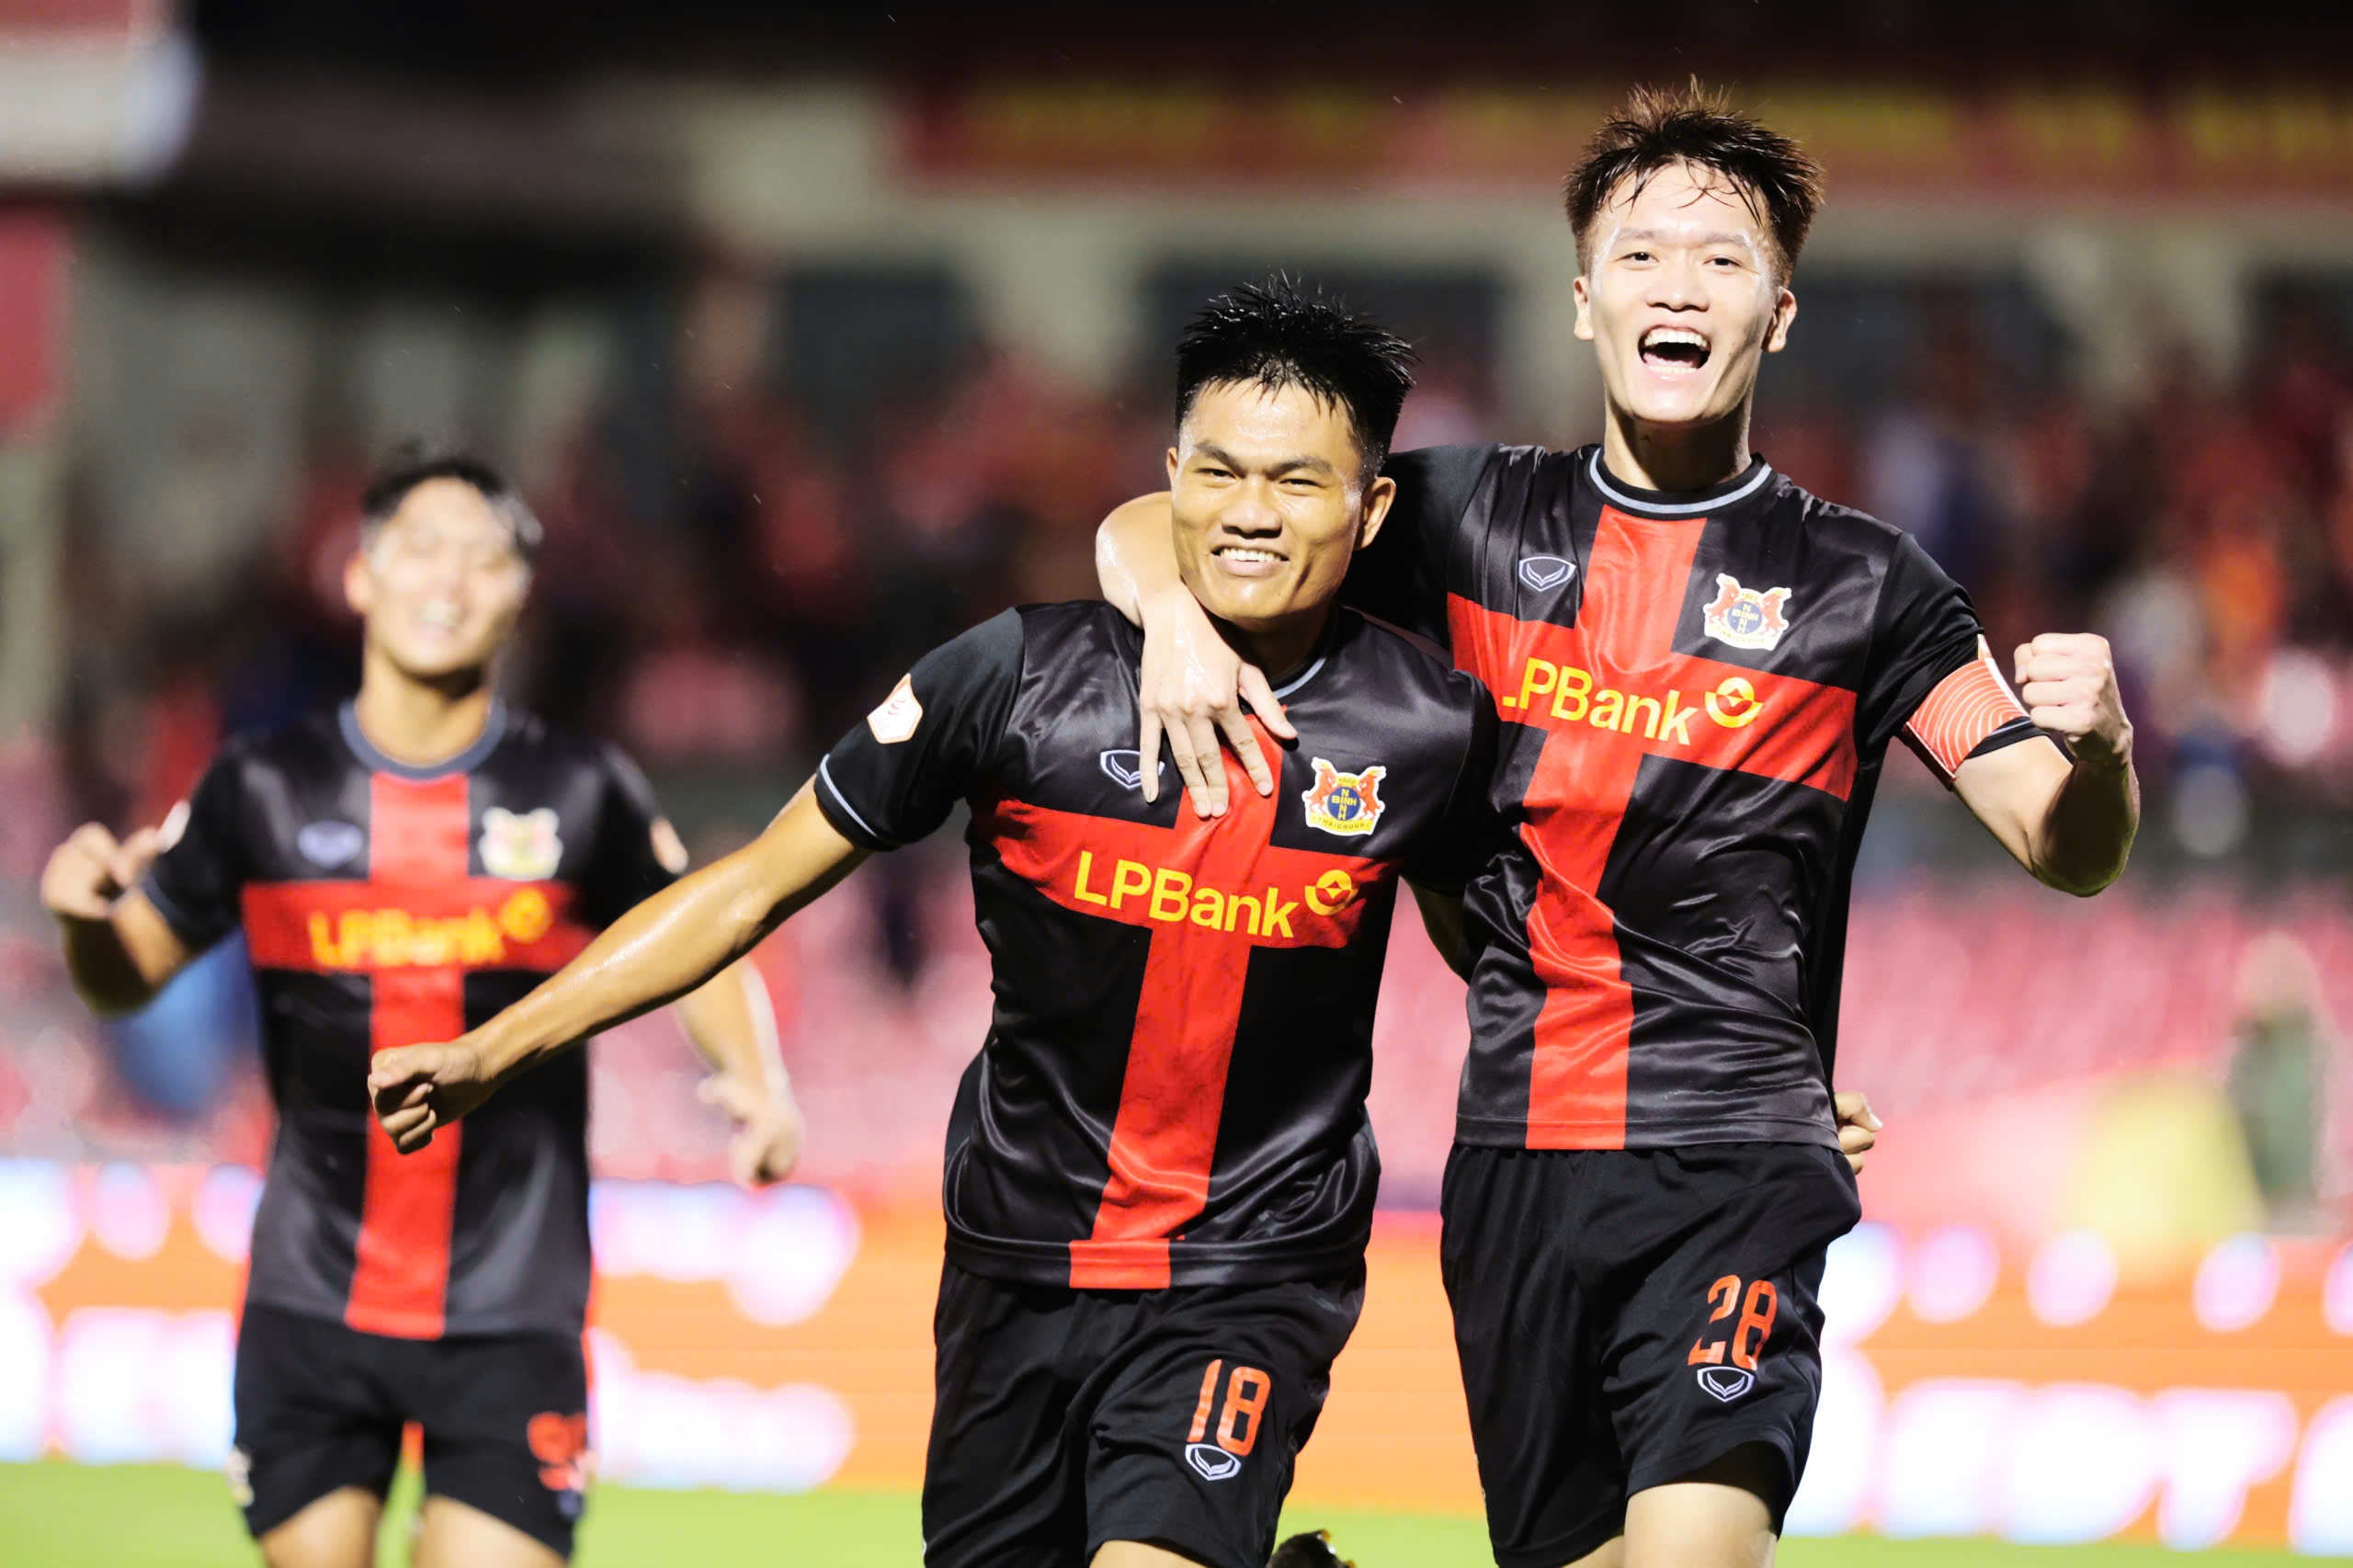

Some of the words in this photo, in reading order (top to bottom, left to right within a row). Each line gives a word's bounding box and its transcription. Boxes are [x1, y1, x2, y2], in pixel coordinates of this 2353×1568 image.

[1502, 657, 1699, 745] PBank
[1074, 850, 1299, 938] LPBank
[1688, 1274, 1778, 1371] 28
[1187, 1358, 1271, 1457] 18
